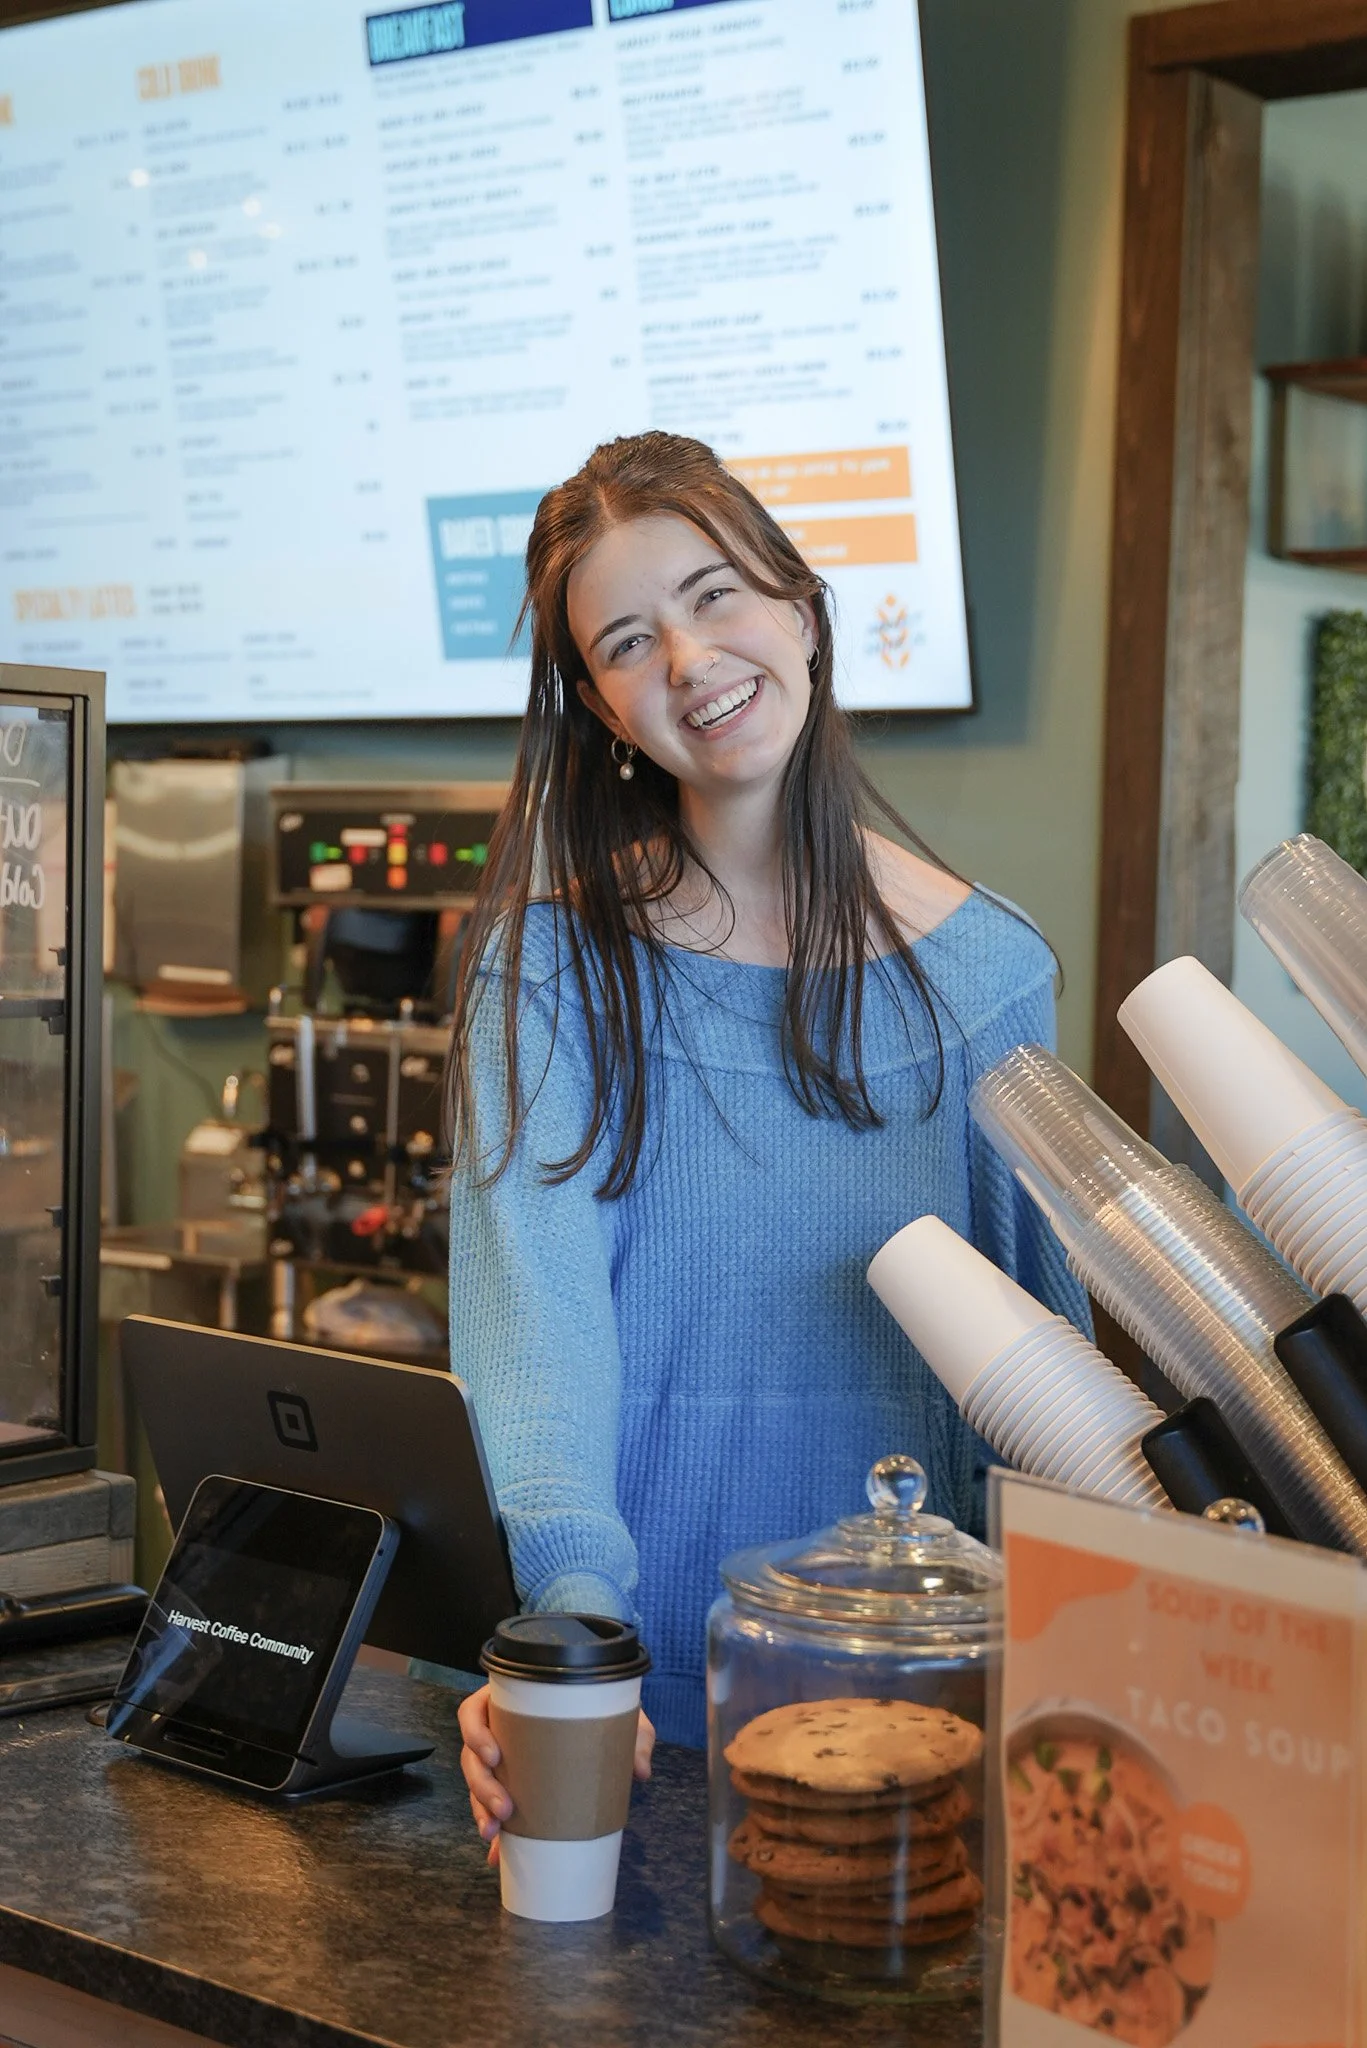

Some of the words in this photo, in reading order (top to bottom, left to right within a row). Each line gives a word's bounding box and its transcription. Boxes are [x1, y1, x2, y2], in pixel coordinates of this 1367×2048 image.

[367, 2, 466, 63] BREAKFAST
[167, 1609, 211, 1634] Harvest
[210, 1621, 249, 1645] Coffee
[249, 1632, 315, 1665] Community
[1145, 1578, 1222, 1627] SOUP
[1230, 1601, 1268, 1638] OF
[1276, 1610, 1331, 1655] THE
[1199, 1650, 1274, 1695] WEEK
[1126, 1684, 1228, 1745] TACO
[1243, 1719, 1356, 1784] SOUP
